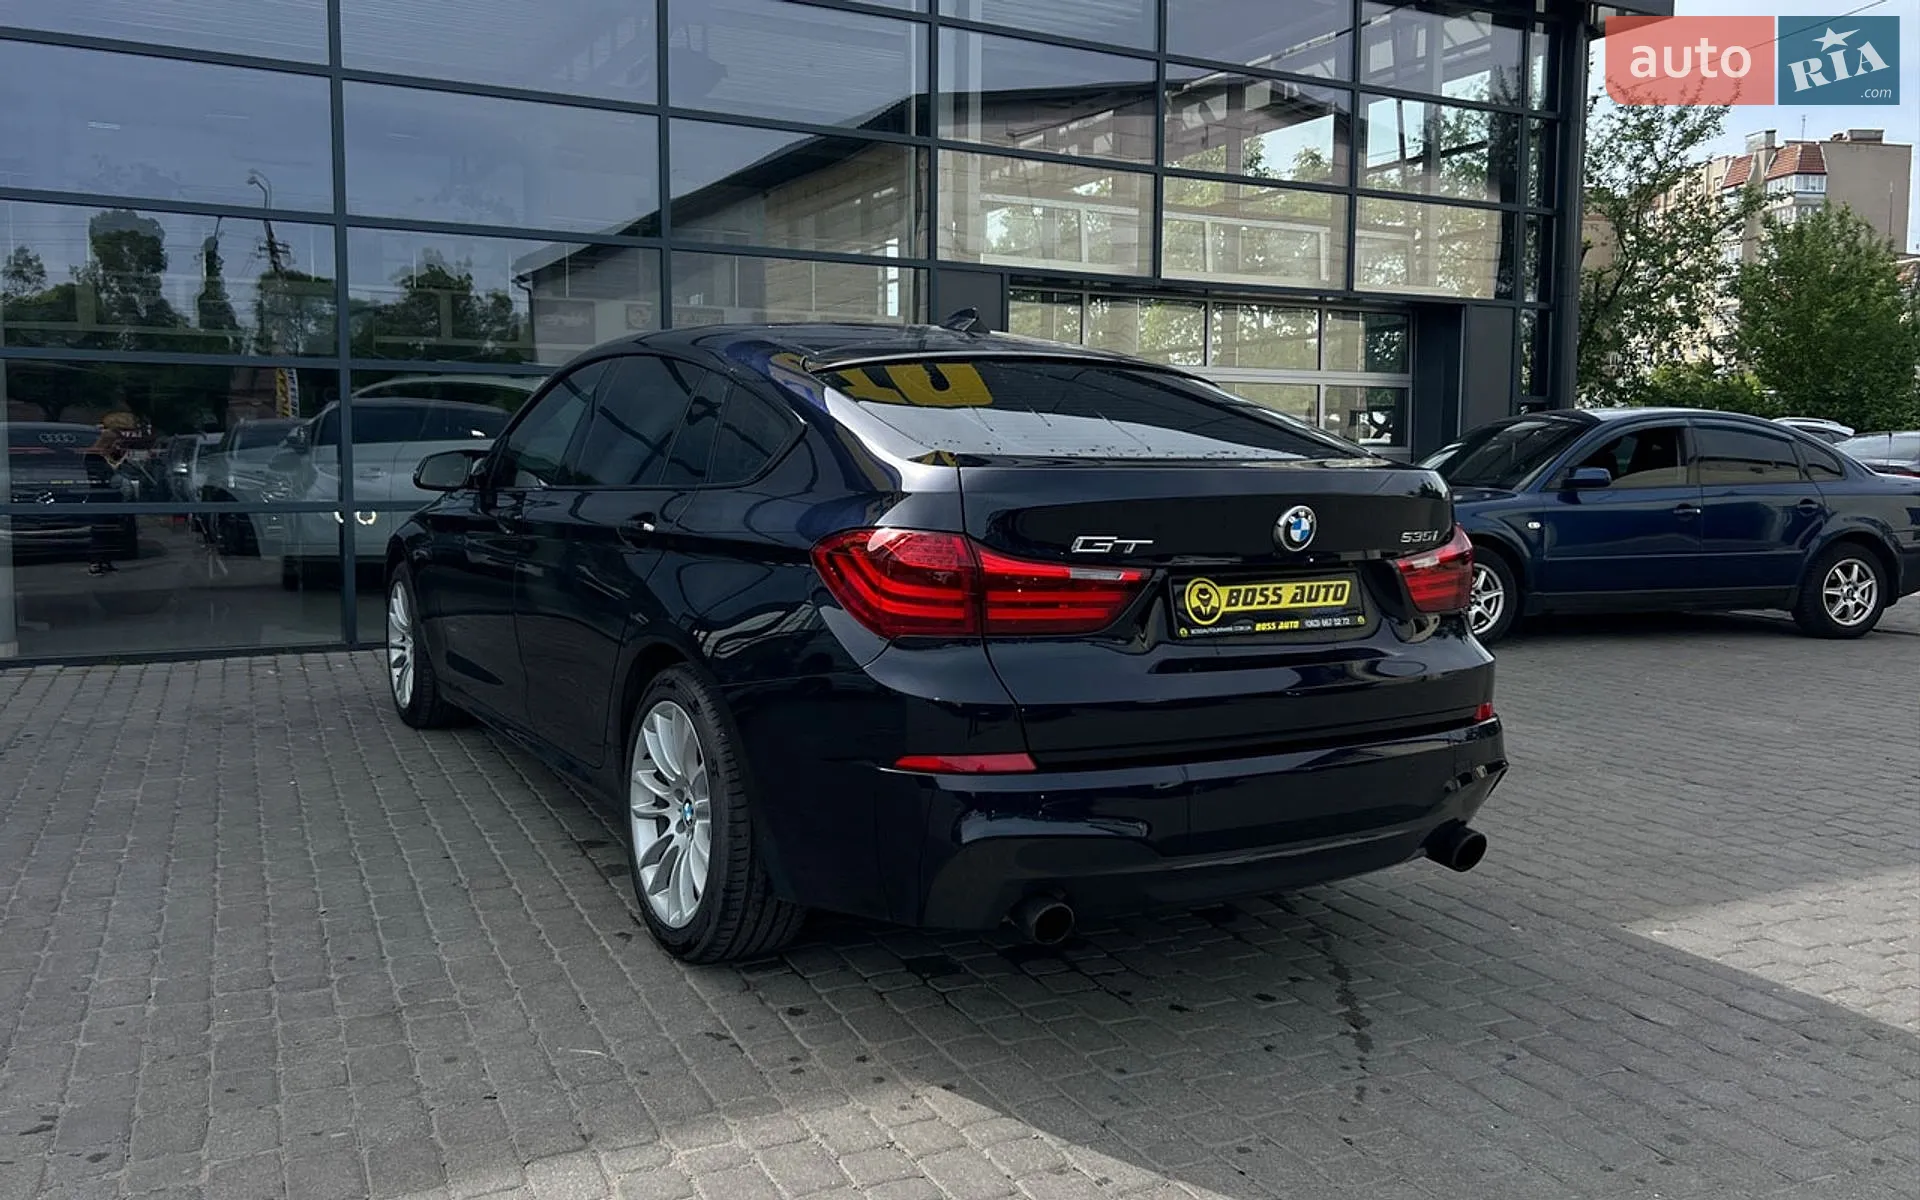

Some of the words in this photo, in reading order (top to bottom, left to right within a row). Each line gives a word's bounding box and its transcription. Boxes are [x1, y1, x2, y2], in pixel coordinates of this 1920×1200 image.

[1071, 535, 1154, 554] GT
[1225, 586, 1283, 607] BOSS
[1289, 583, 1348, 604] AUTO
[1255, 621, 1278, 631] BOSS
[1278, 620, 1299, 630] AUTO
